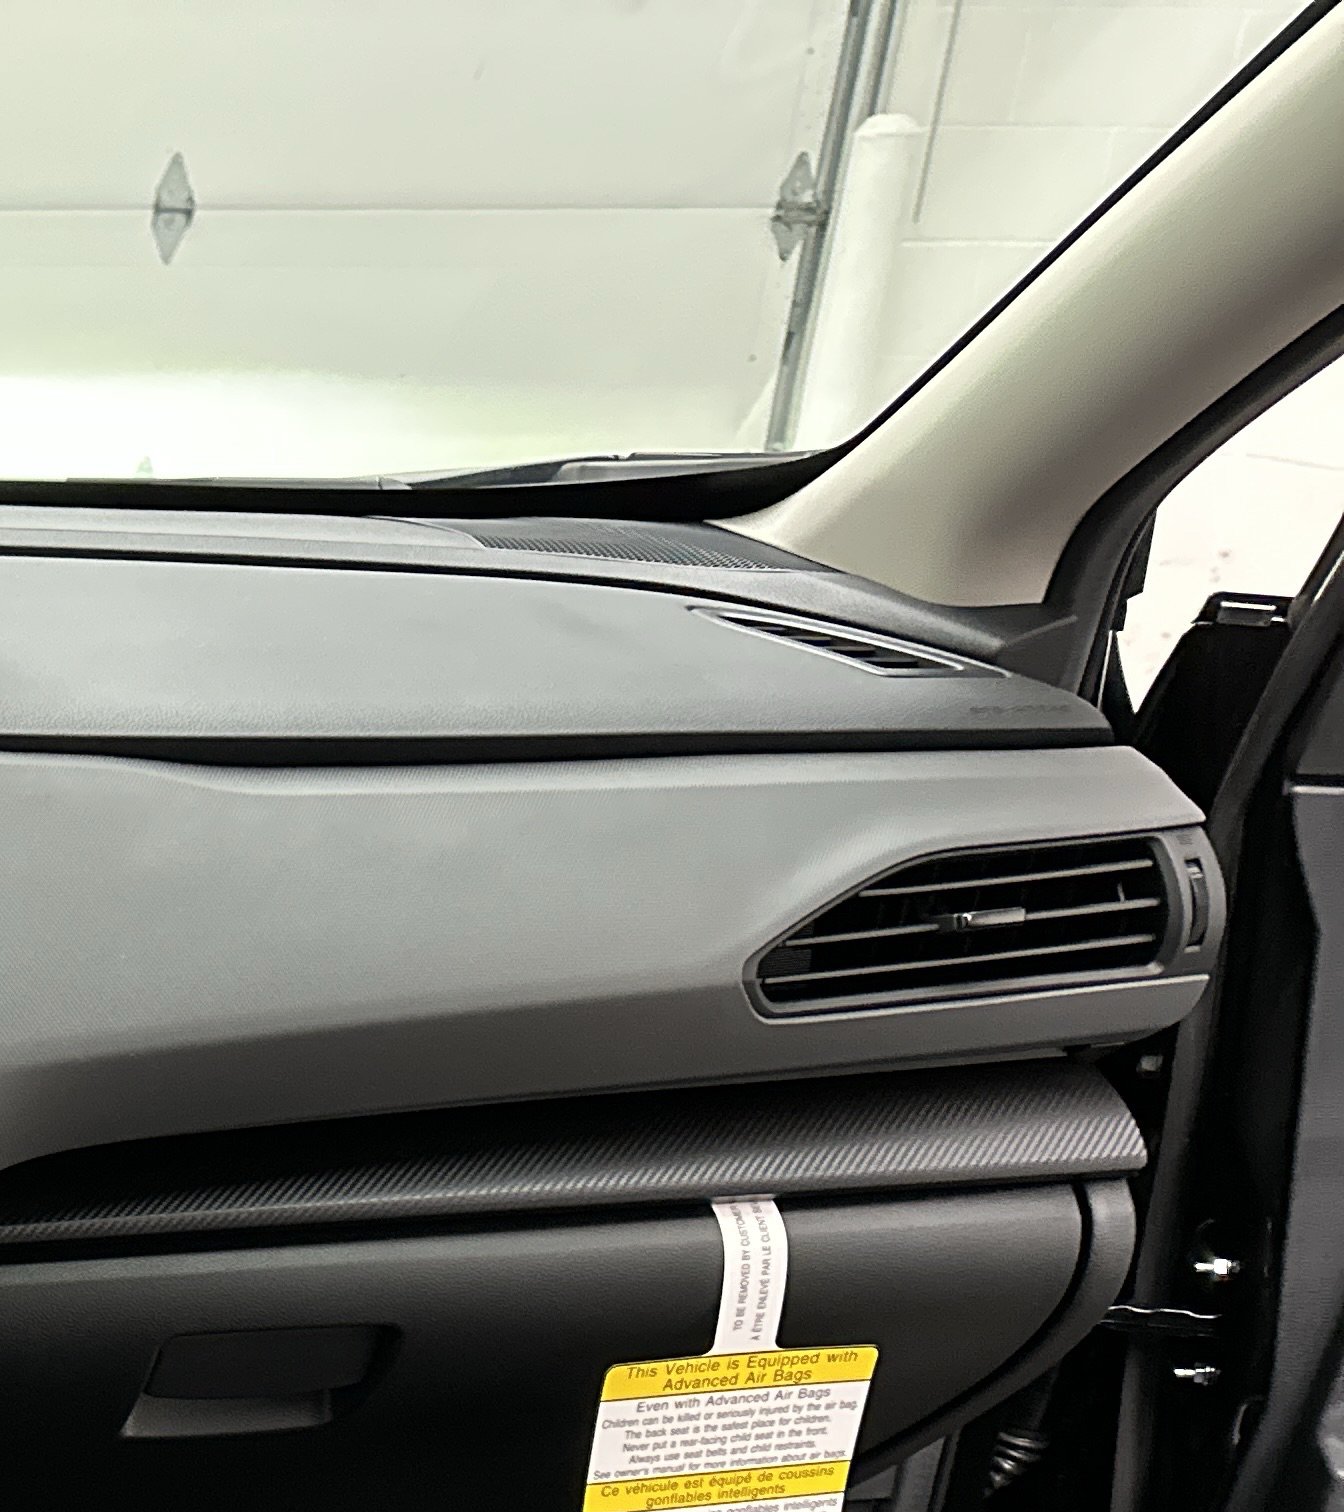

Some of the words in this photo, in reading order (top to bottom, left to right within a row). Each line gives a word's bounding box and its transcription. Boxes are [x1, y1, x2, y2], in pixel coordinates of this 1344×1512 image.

[756, 1214, 771, 1243] CLIENT
[741, 1249, 751, 1261] BY
[762, 1245, 772, 1256] LE
[761, 1256, 771, 1276] PAR
[738, 1263, 751, 1305] REMOVED
[735, 1306, 746, 1319] BE
[732, 1319, 744, 1332] TO
[627, 1366, 657, 1380] This
[666, 1359, 720, 1376] Vehicle
[727, 1357, 740, 1370] is
[746, 1352, 820, 1371] Equipped
[827, 1350, 859, 1363] with
[663, 1374, 738, 1391] Advanced
[745, 1371, 767, 1385] Air
[773, 1368, 812, 1384] Bags
[636, 1401, 669, 1412] Even
[674, 1399, 701, 1409] with
[705, 1391, 770, 1406] Advanced
[774, 1390, 793, 1400] Air
[798, 1388, 831, 1400] Bags
[601, 1418, 640, 1429] Children
[642, 1417, 659, 1426] can
[662, 1415, 674, 1424] be
[677, 1413, 701, 1422] killed
[703, 1412, 714, 1420] or
[716, 1407, 756, 1419] seriously
[759, 1405, 790, 1416] injured
[792, 1404, 804, 1414] by
[806, 1402, 822, 1411] the
[623, 1442, 650, 1452] Never
[652, 1440, 667, 1451] put
[730, 1432, 752, 1442] child
[754, 1431, 774, 1441] seat
[788, 1428, 803, 1438] the
[625, 1429, 642, 1439] The
[645, 1428, 666, 1438] back
[670, 1426, 690, 1436] seat
[703, 1423, 719, 1432] the
[751, 1419, 775, 1430] place
[778, 1417, 792, 1425] for
[629, 1454, 660, 1464] Always
[663, 1452, 680, 1461] use
[683, 1450, 703, 1459] seat
[730, 1445, 748, 1455] and
[750, 1443, 772, 1453] child
[593, 1470, 611, 1480] See
[688, 1462, 701, 1471] for
[781, 1452, 807, 1463] about
[601, 1485, 620, 1498] Ce
[625, 1479, 679, 1496] véhicule
[683, 1477, 704, 1490] est
[758, 1470, 774, 1482] de
[778, 1465, 834, 1481] coussins
[645, 1490, 712, 1509] gonflables
[717, 1483, 786, 1501] intelligents
